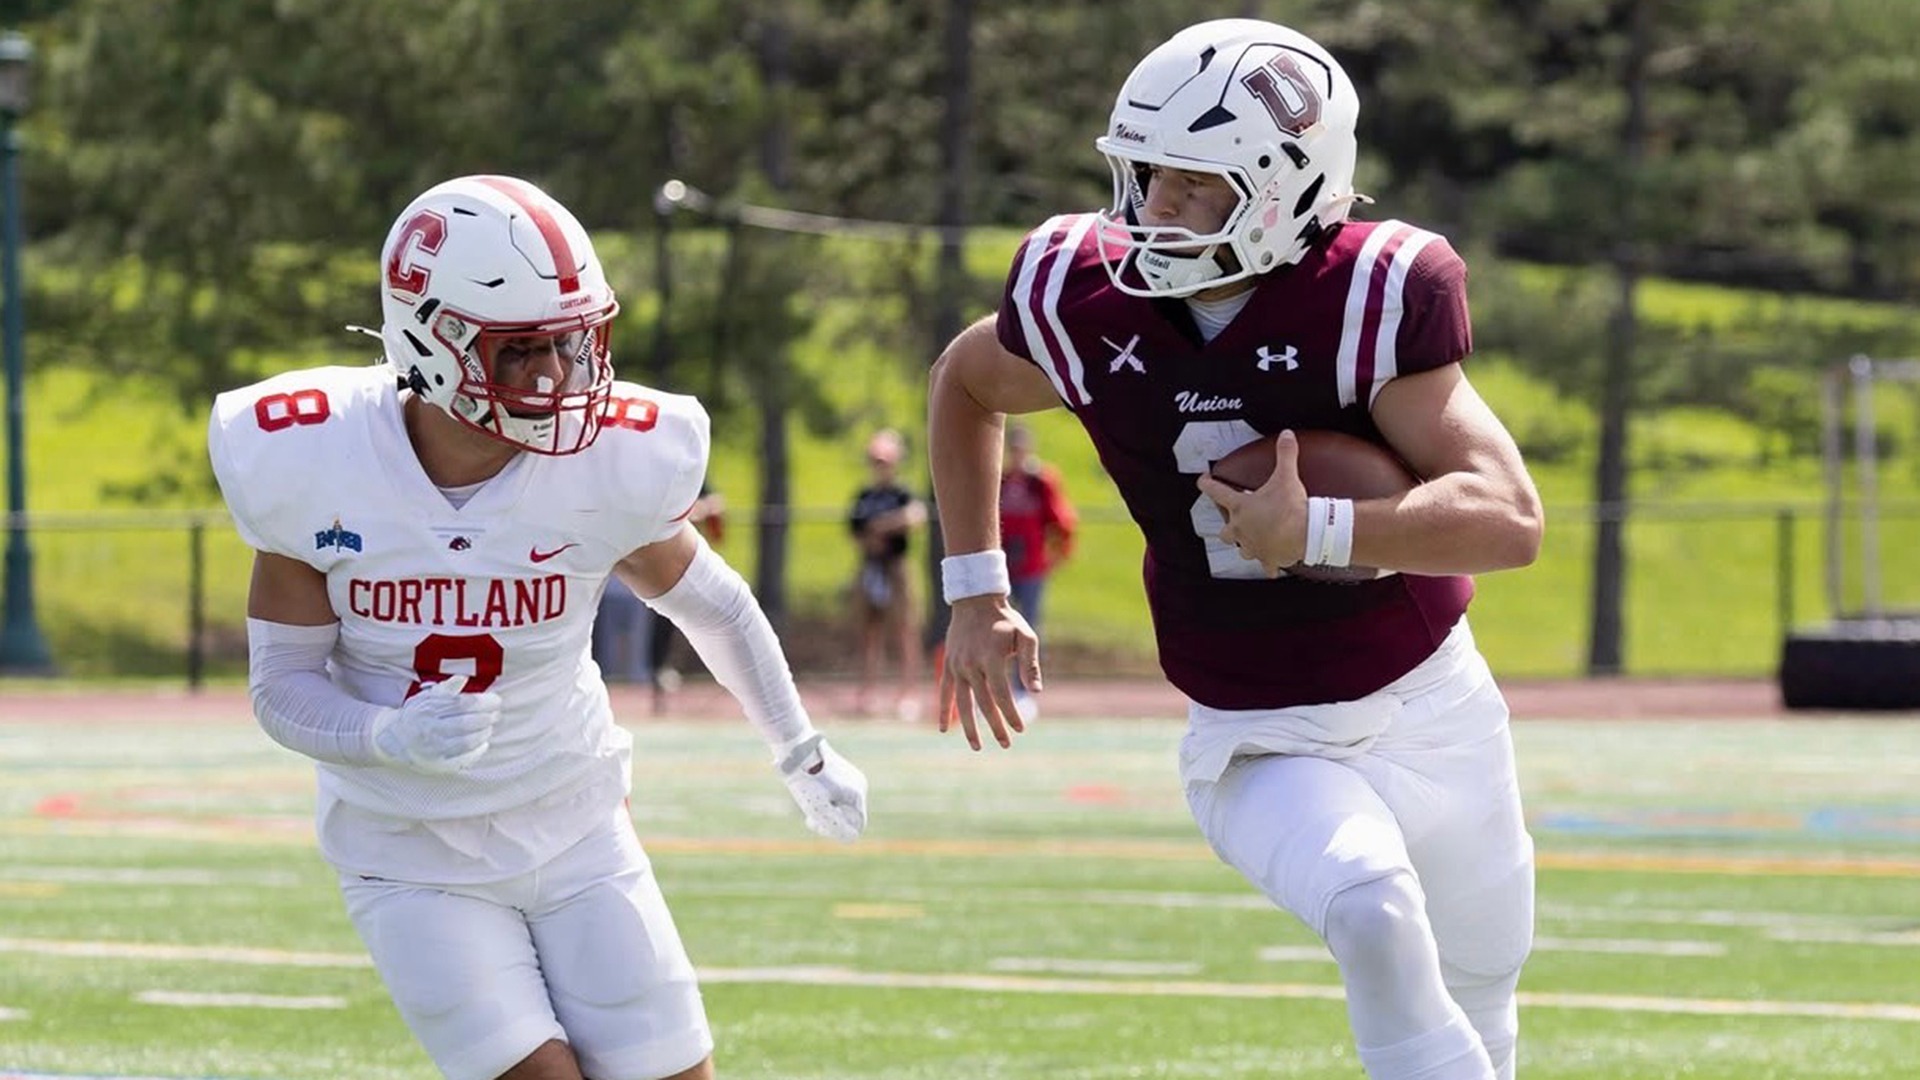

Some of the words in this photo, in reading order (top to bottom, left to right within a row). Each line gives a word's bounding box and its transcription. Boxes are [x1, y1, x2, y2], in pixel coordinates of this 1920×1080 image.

[1241, 52, 1323, 139] U
[1115, 122, 1147, 144] Union
[387, 208, 448, 297] C
[254, 389, 331, 433] 8
[596, 396, 660, 433] 8
[1174, 390, 1243, 413] Union
[349, 573, 566, 628] CORTLAND
